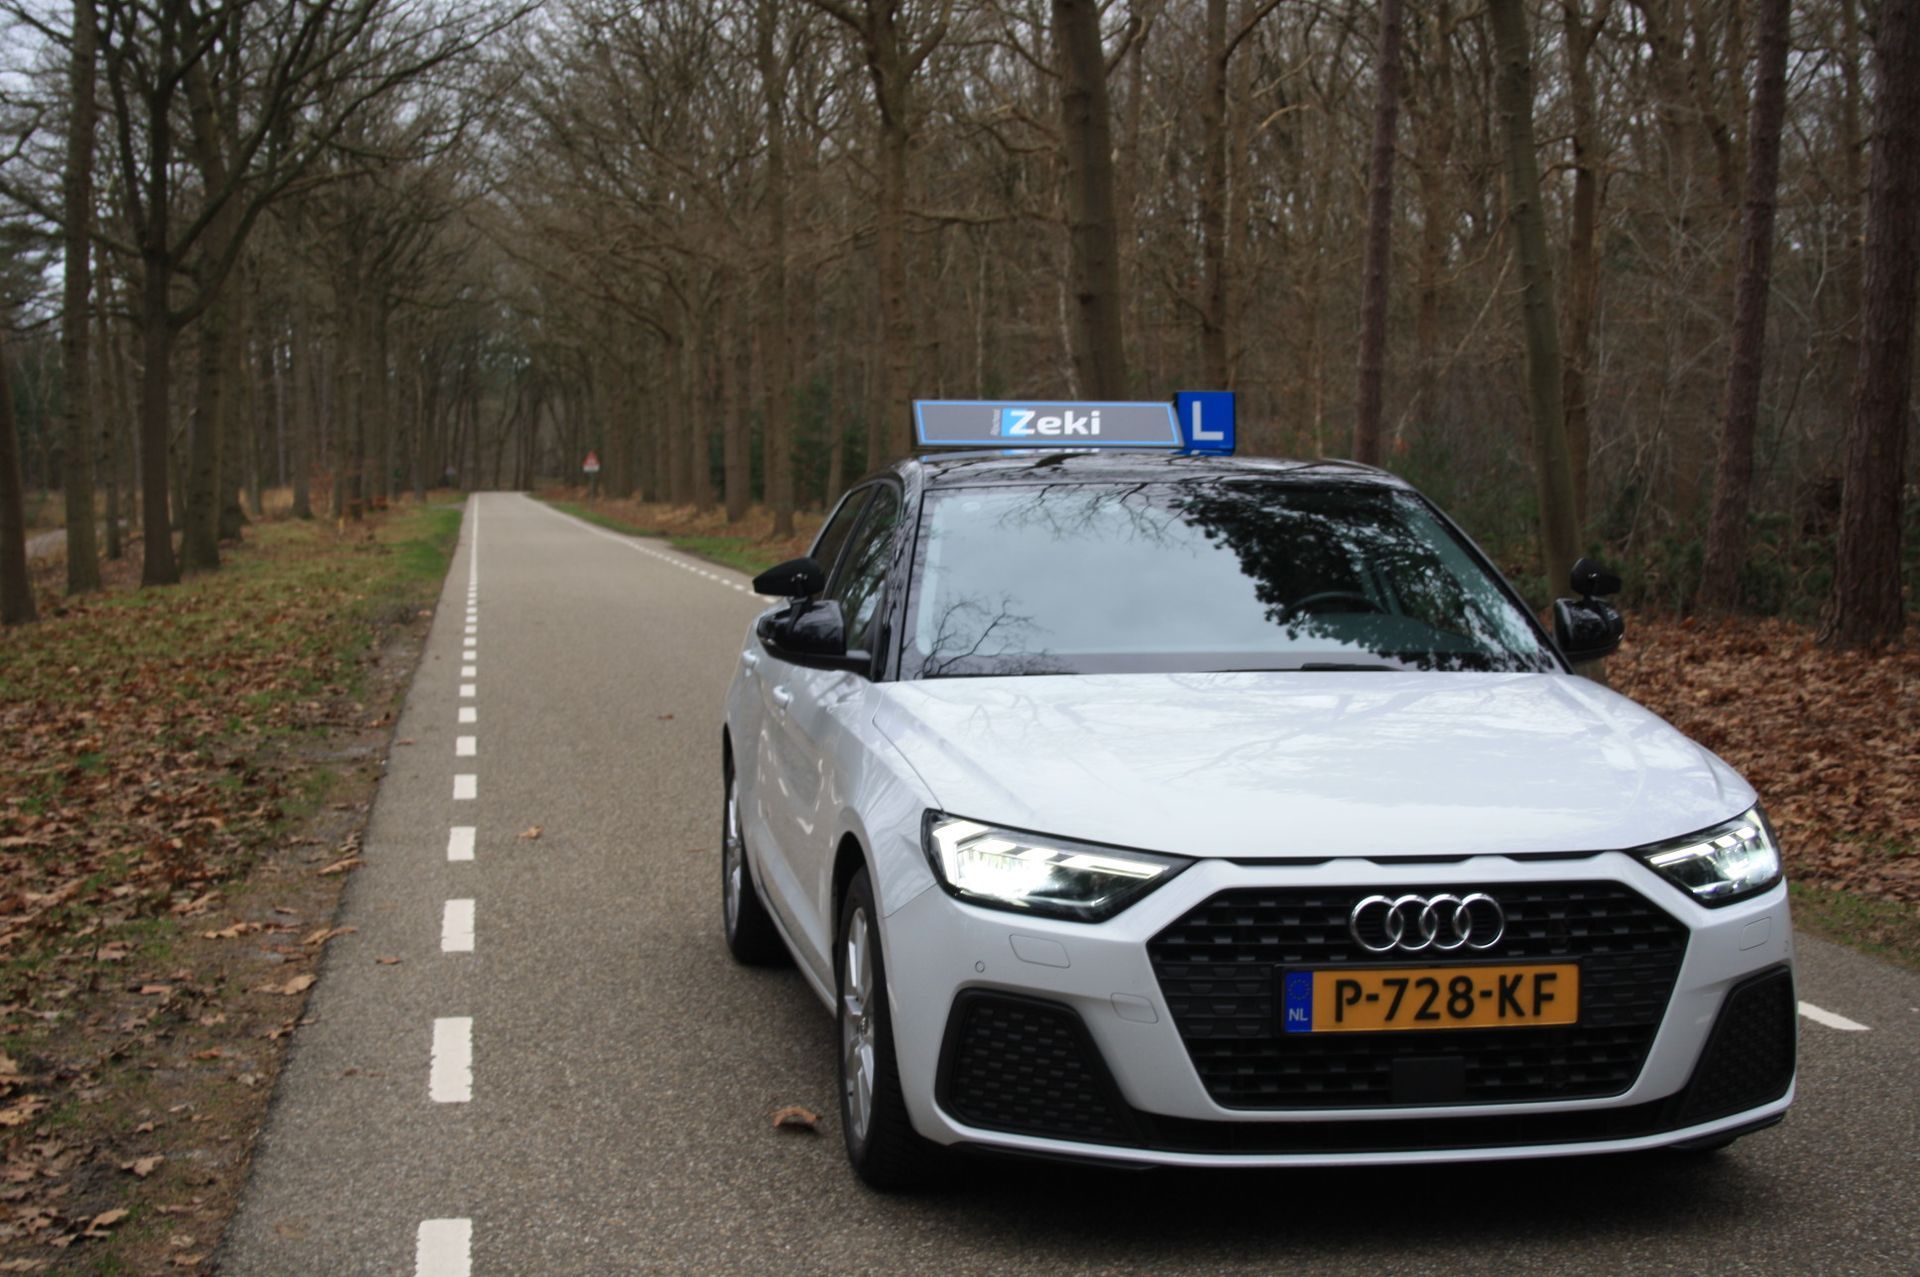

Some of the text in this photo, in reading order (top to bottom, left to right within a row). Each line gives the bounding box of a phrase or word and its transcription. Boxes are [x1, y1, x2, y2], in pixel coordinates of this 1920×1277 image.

[1009, 410, 1101, 436] Zeki
[1192, 400, 1224, 441] L
[1288, 1007, 1309, 1022] NL
[1334, 973, 1557, 1023] P-728-KF
